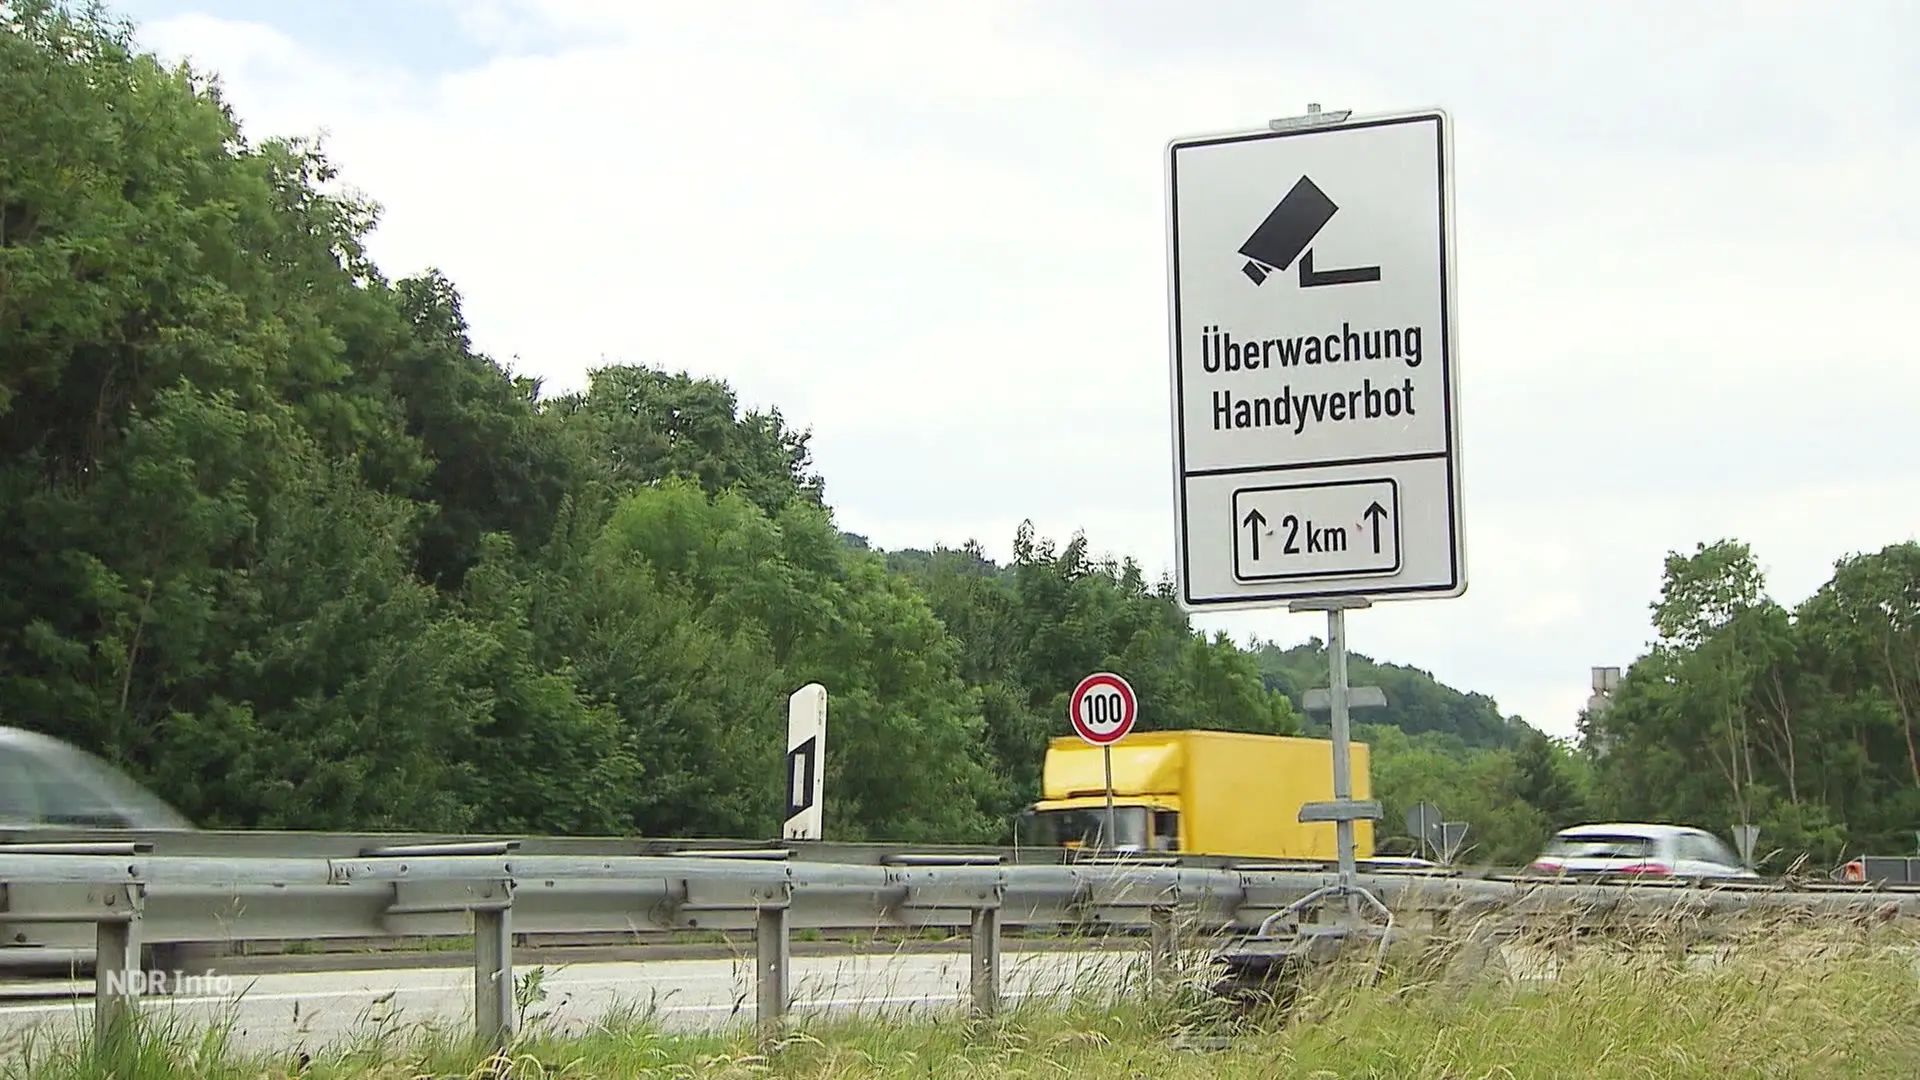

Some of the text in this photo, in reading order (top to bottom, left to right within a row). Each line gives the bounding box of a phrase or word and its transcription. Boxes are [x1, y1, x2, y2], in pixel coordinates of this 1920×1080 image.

[1202, 323, 1422, 373] Überwachung
[1213, 378, 1415, 435] Handyverbot
[1282, 515, 1347, 554] 2 km
[1084, 693, 1122, 724] 100
